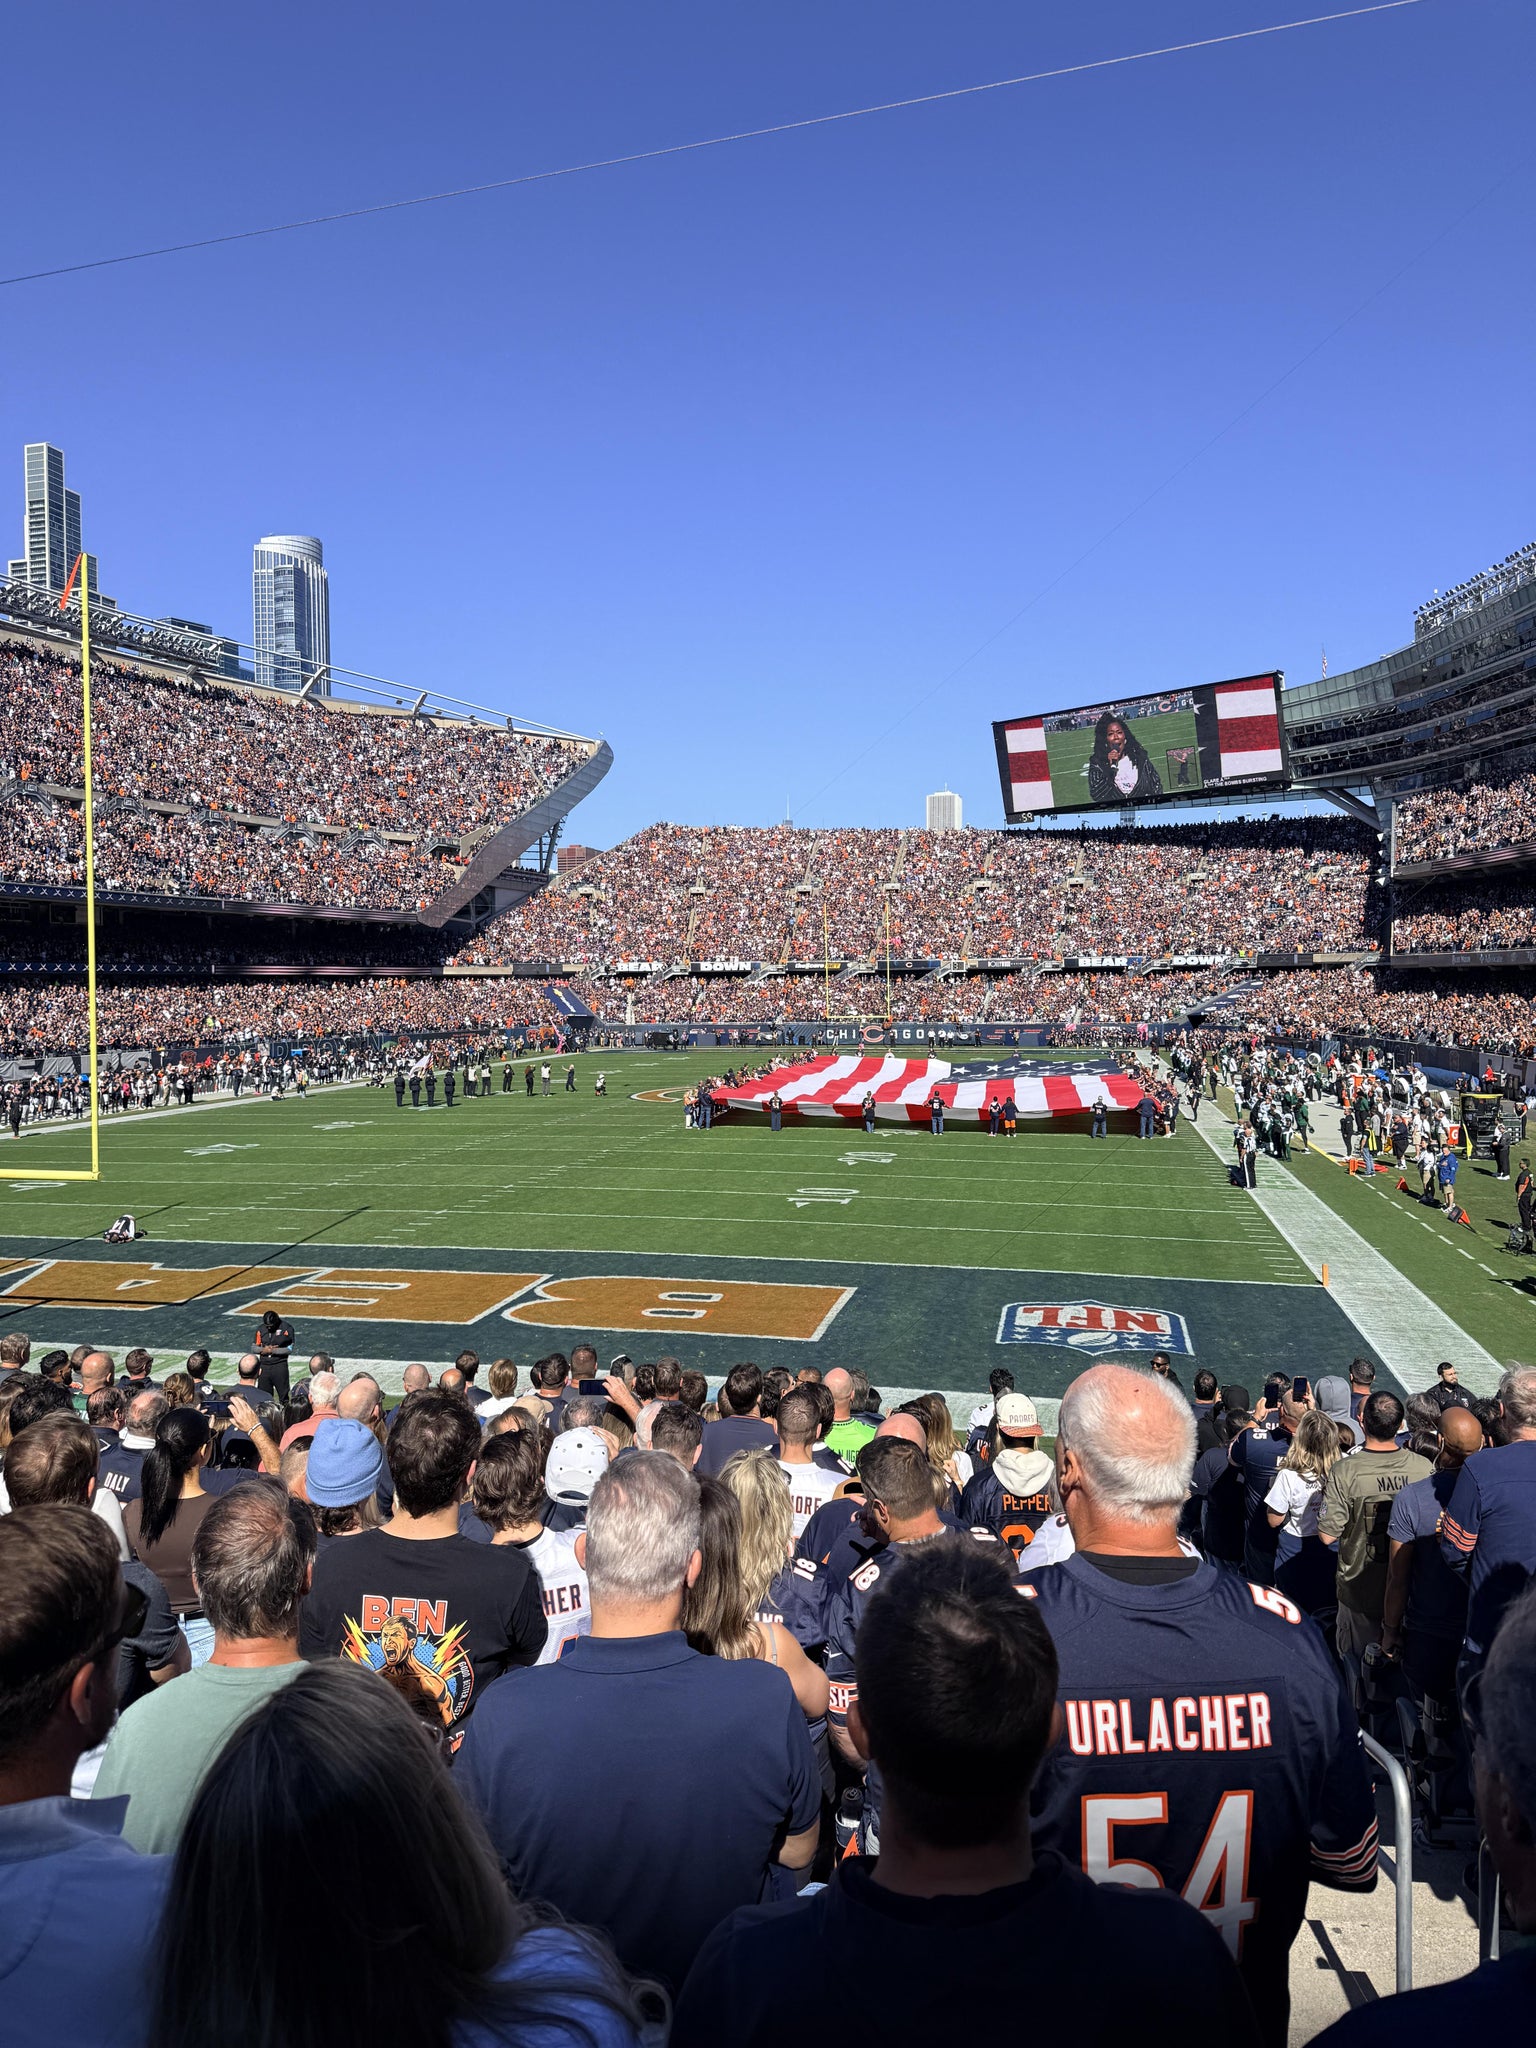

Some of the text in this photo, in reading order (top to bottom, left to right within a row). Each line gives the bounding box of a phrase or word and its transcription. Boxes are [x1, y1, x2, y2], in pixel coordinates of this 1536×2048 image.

[700, 961, 750, 971] DOWN
[1078, 957, 1128, 967] BEAR
[1173, 957, 1228, 966] DOWN
[1023, 1305, 1167, 1333] NFL
[1009, 1414, 1035, 1424] PADRES
[103, 1471, 131, 1493] DALY
[1376, 1475, 1409, 1492] MACK
[791, 1495, 822, 1515] ORE
[848, 1557, 881, 1592] 18
[362, 1594, 448, 1636] BEN
[1065, 1691, 1273, 1756] URLACHER
[1081, 1789, 1260, 1965] 54
